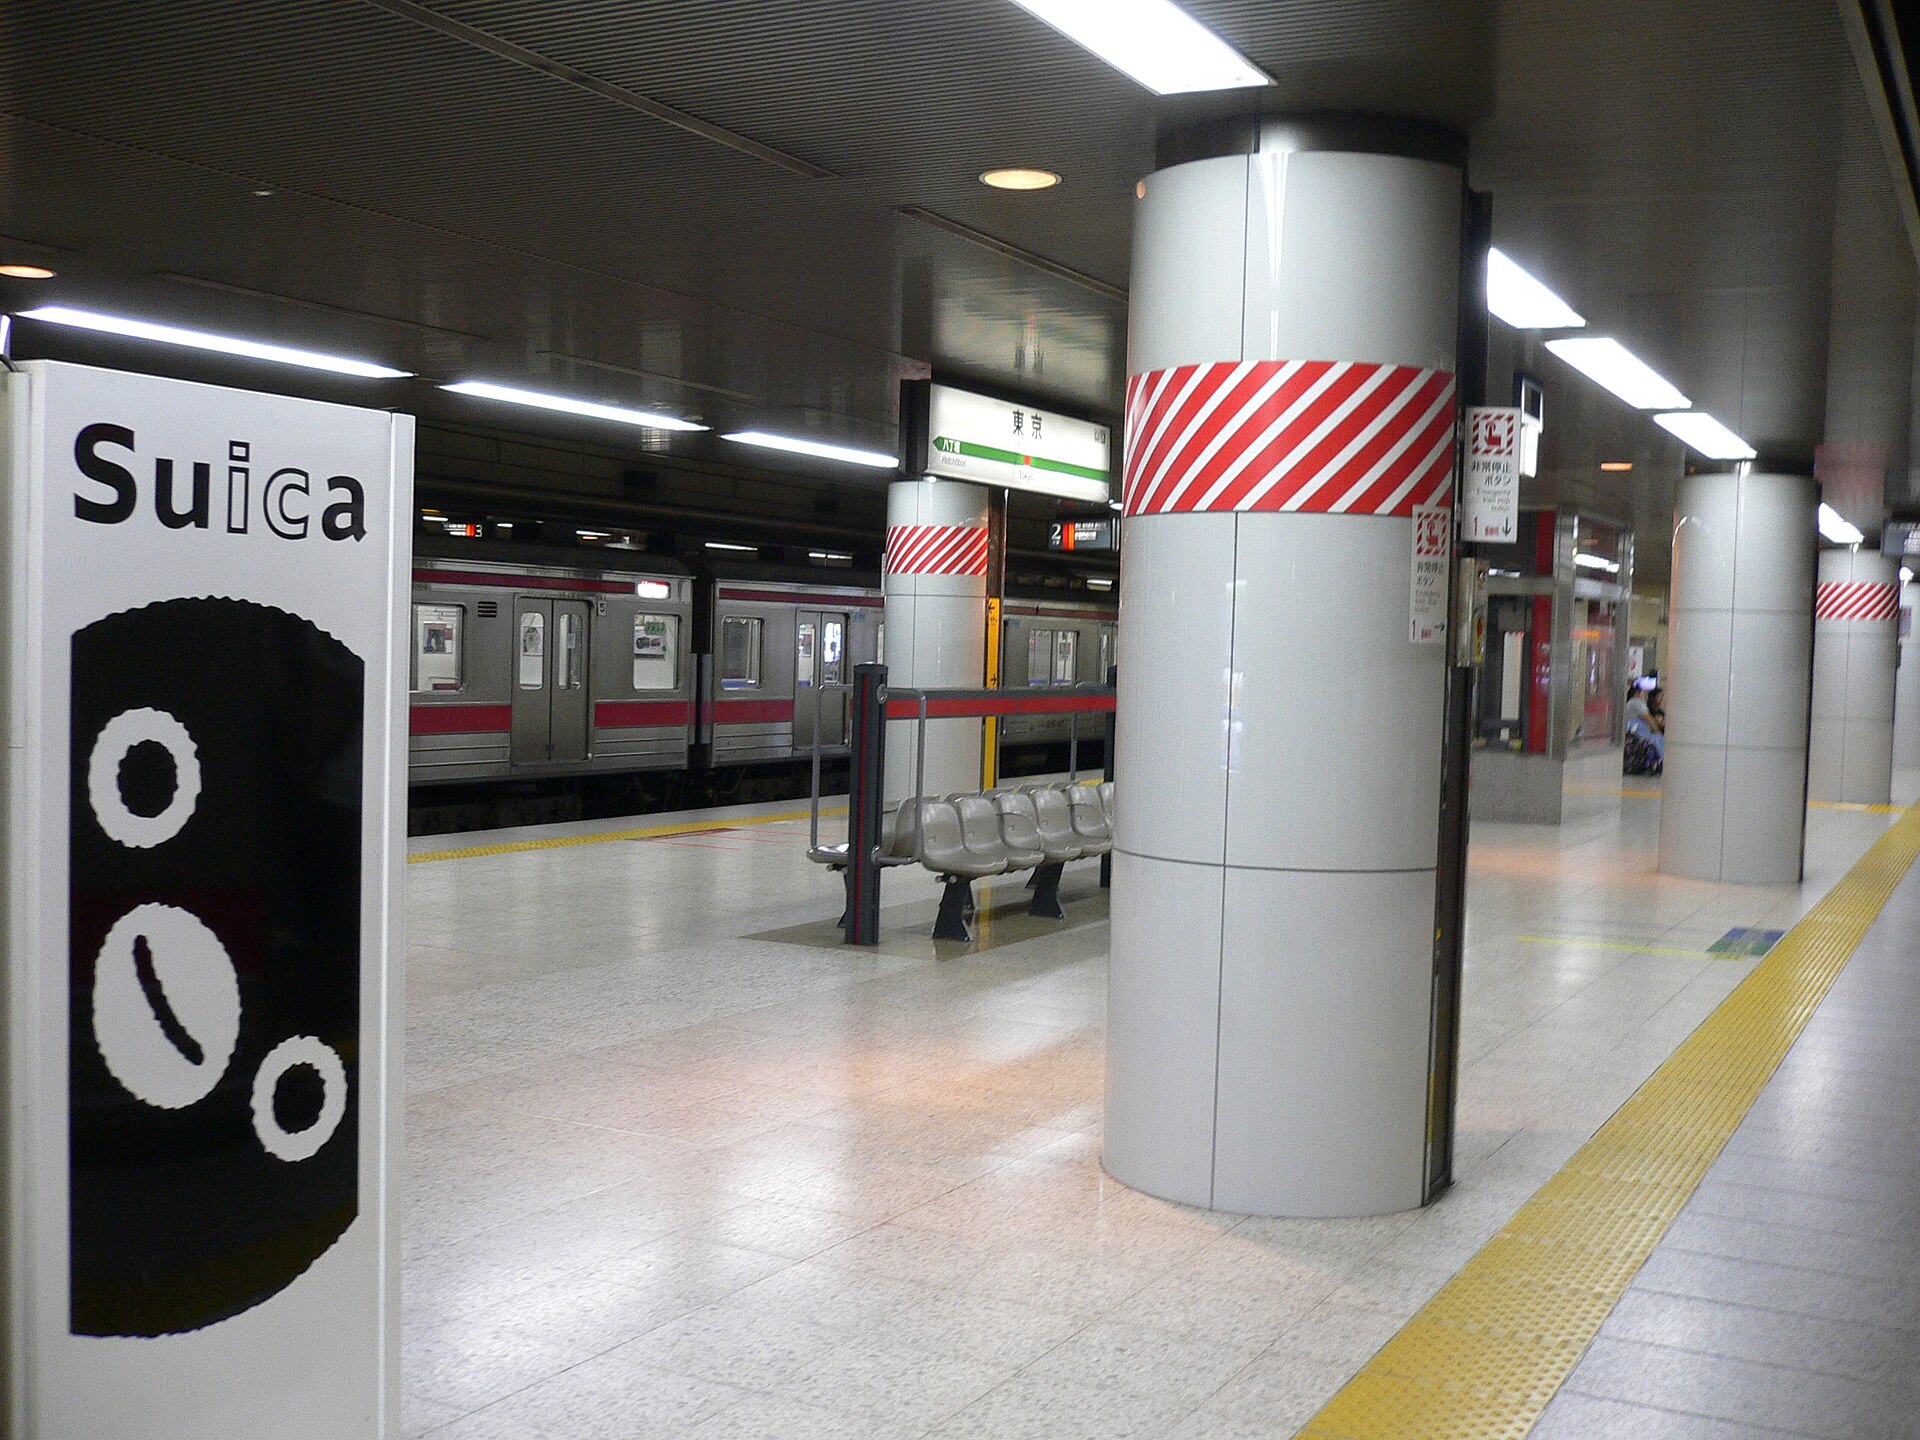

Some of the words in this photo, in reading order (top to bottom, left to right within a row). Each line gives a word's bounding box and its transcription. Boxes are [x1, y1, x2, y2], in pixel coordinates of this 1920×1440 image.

[1012, 409, 1043, 440] 東京
[73, 422, 367, 543] Suica
[475, 524, 483, 537] 3
[1051, 523, 1061, 540] 2
[600, 603, 605, 612] 5
